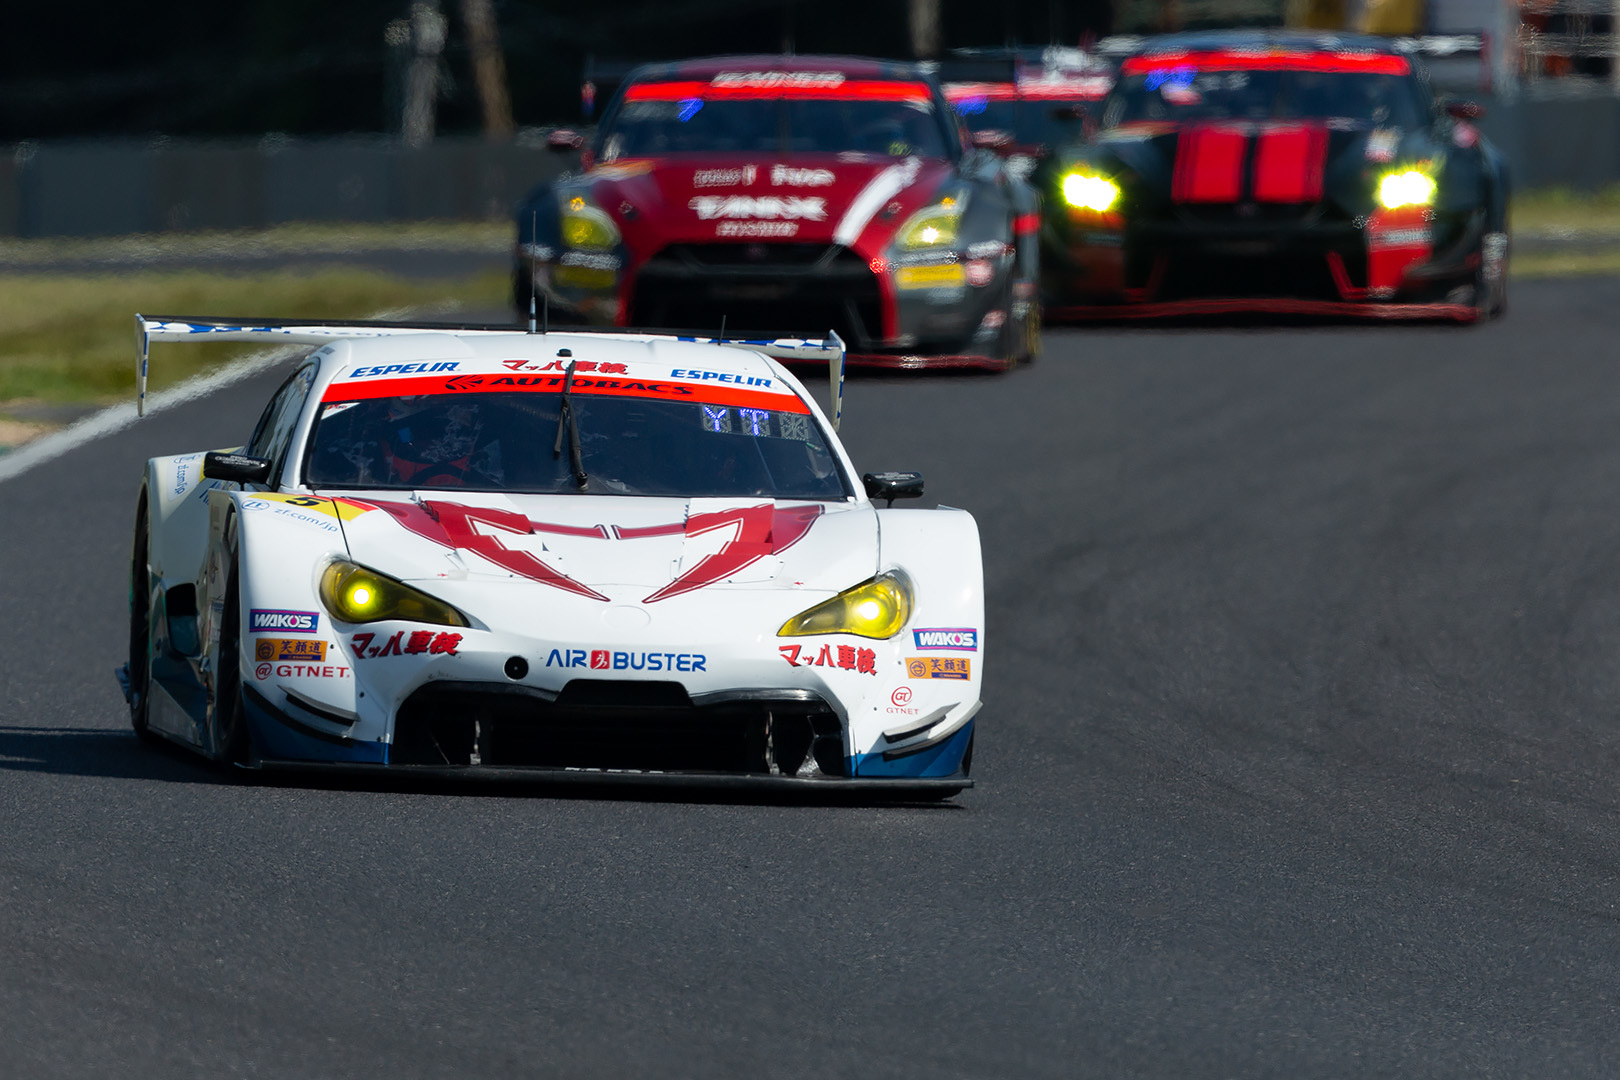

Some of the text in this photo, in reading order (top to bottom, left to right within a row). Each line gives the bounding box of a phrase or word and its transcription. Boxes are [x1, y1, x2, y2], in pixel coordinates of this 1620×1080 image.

[349, 362, 461, 378] ESPELIR
[502, 360, 628, 374] マッハ車検
[489, 377, 693, 394] AUTOBACS
[671, 369, 773, 388] ESPELIR
[285, 497, 329, 506] 5
[275, 508, 338, 532] zf.com/jp
[280, 640, 322, 654] 笑顔道
[350, 631, 463, 659] マッハ車検
[545, 649, 706, 671] AIR BUSTER
[779, 644, 877, 676] マッハ車検
[930, 658, 968, 673] 笑顔道
[276, 665, 348, 678] GTNET
[886, 707, 919, 715] GTNET
